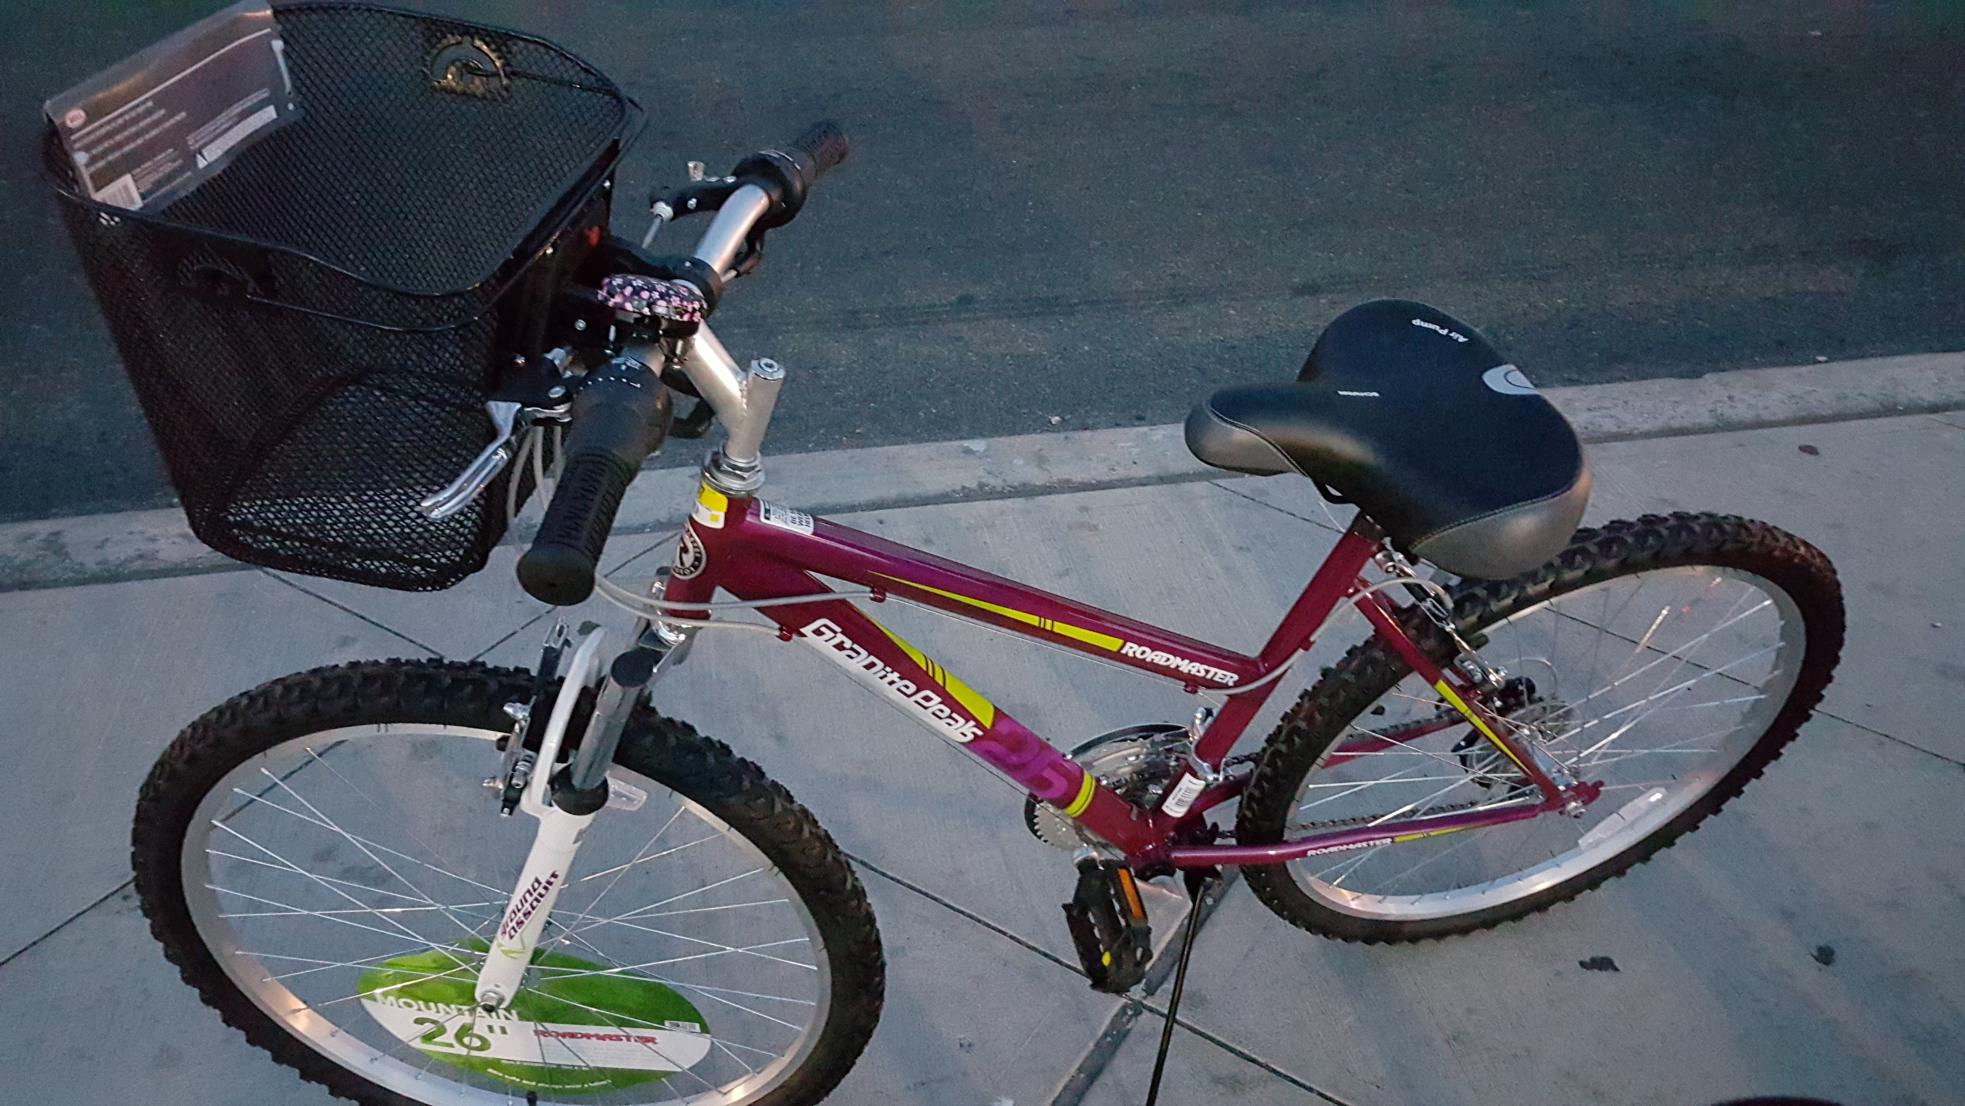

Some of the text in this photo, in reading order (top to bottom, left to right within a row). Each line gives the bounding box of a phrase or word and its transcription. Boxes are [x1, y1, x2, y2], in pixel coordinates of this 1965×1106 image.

[1411, 318, 1469, 342] Air Pump
[1120, 641, 1240, 686] ROADMASTER
[374, 992, 519, 1021] MOUNTAIN
